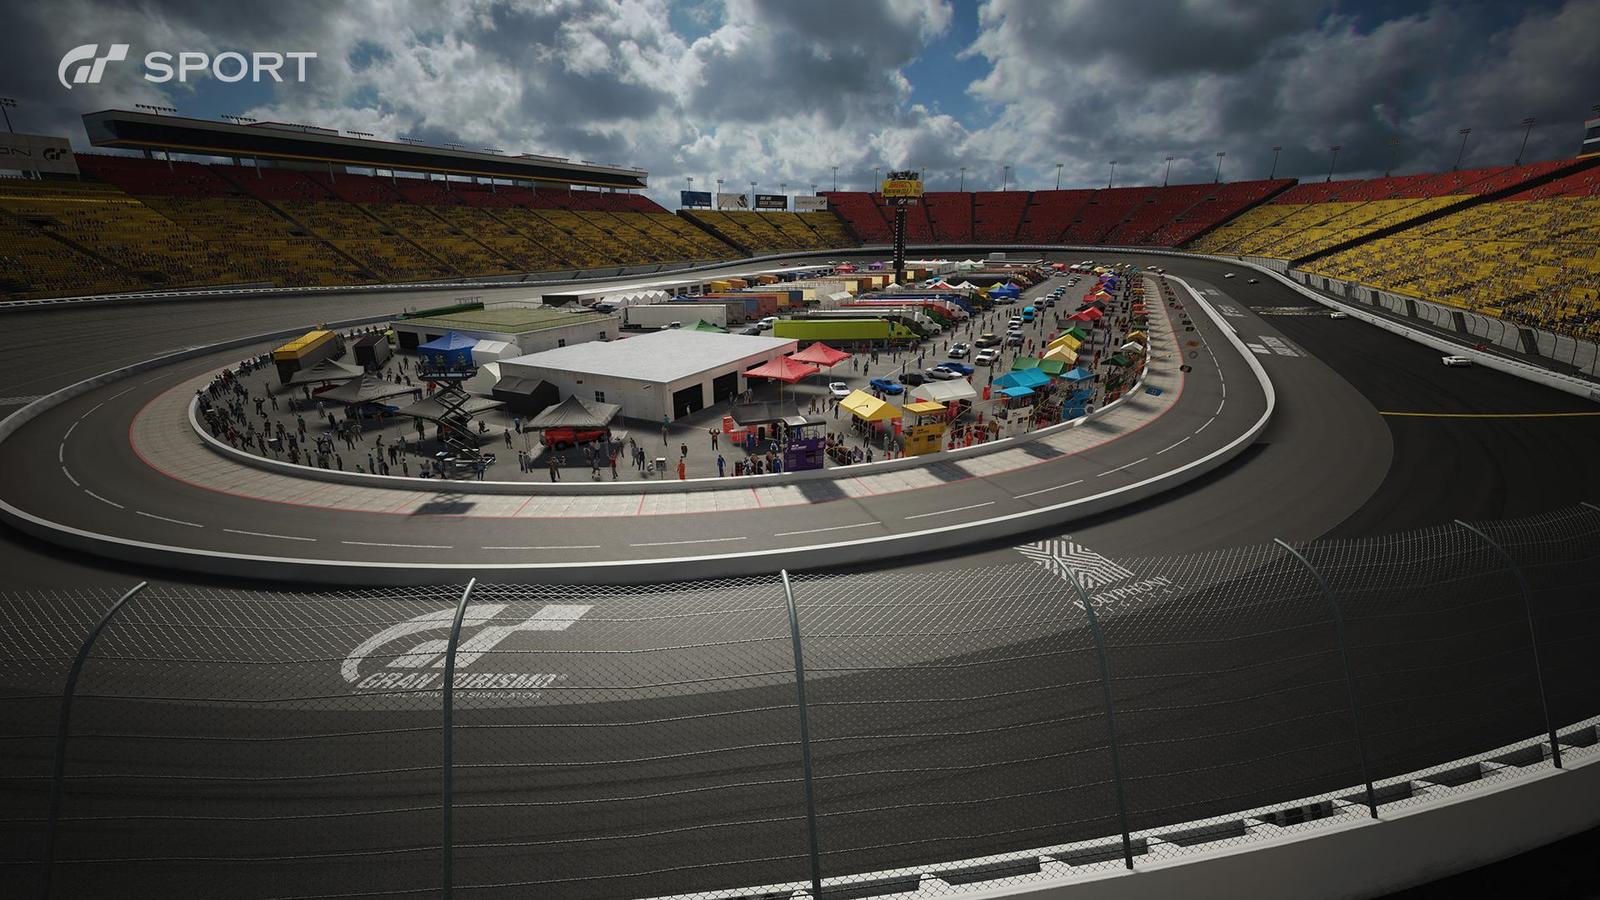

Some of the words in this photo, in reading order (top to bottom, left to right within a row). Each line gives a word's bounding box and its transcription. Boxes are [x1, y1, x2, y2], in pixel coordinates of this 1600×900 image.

[1073, 575, 1173, 611] POLYPHONY
[356, 672, 441, 689] GRAN
[466, 690, 544, 699] SIMULATOR
